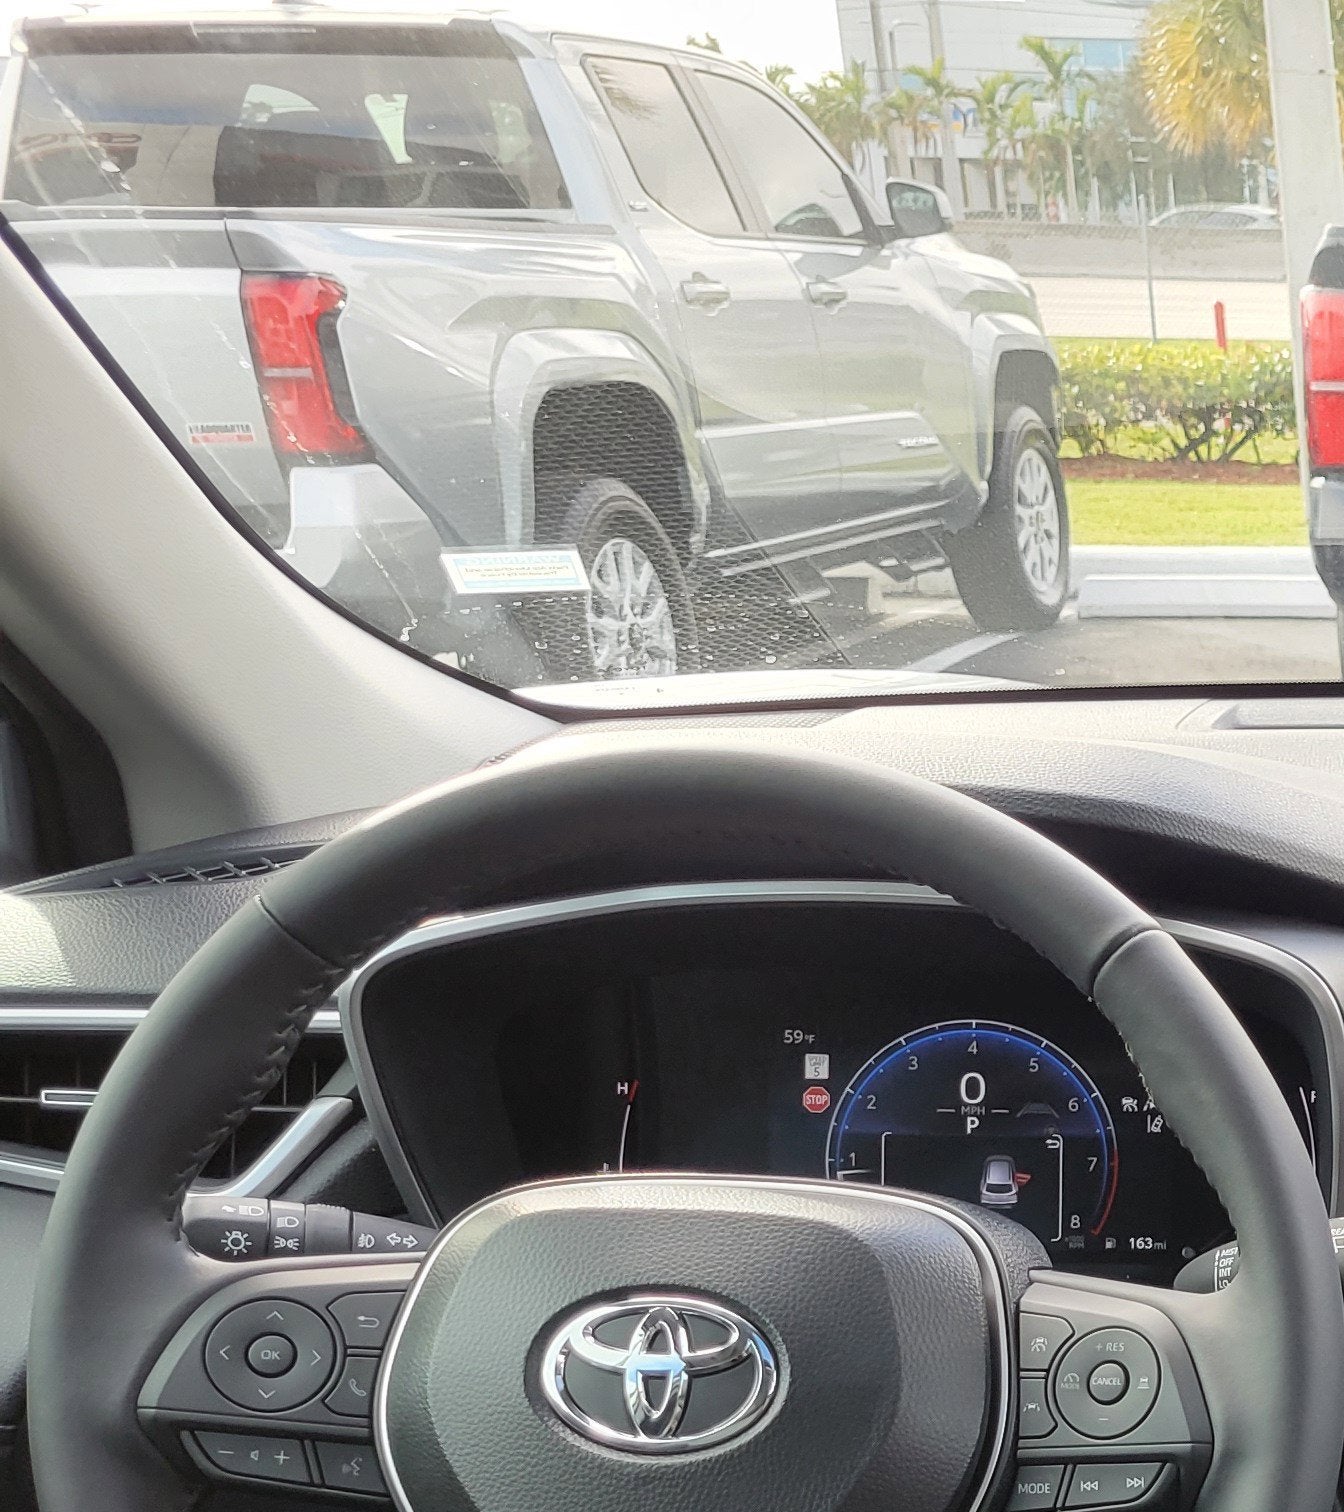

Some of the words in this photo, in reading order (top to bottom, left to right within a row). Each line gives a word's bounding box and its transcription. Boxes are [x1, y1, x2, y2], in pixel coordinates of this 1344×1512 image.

[967, 1041, 978, 1055] 4
[908, 1056, 918, 1070] 3
[1028, 1058, 1039, 1072] 5
[813, 1066, 820, 1077] 5
[617, 1081, 629, 1095] H
[959, 1072, 986, 1104] 0
[805, 1094, 828, 1105] STOP
[866, 1095, 877, 1109] 2
[1068, 1098, 1079, 1112] 6
[960, 1106, 986, 1115] MPH
[966, 1116, 980, 1134] P
[849, 1152, 856, 1166] 1
[1087, 1157, 1098, 1172] 7
[1070, 1215, 1081, 1229] 8
[1219, 1257, 1235, 1267] OFF
[1218, 1267, 1232, 1277] INT
[1106, 1342, 1125, 1352] RES
[261, 1350, 280, 1360] OK
[1092, 1377, 1122, 1386] CANCEL
[1018, 1482, 1050, 1494] MODE
